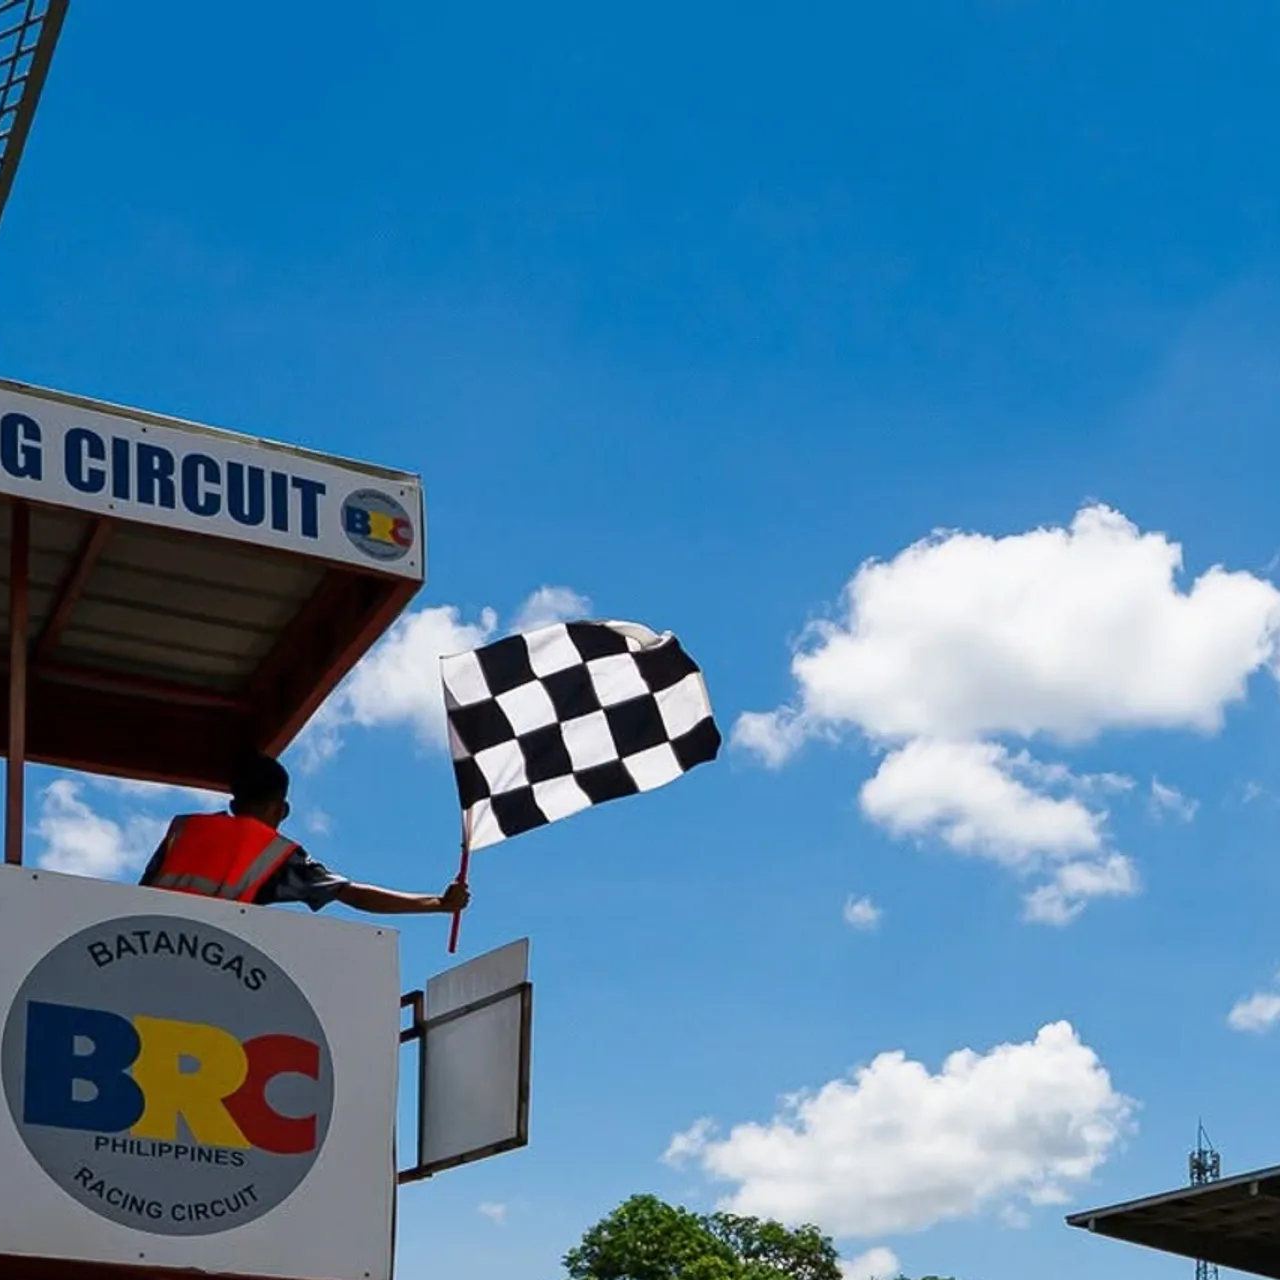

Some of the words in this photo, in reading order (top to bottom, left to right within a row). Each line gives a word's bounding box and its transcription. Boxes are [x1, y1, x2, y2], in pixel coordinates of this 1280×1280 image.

[66, 427, 326, 539] CIRCUIT
[87, 930, 268, 992] BATANGAS
[23, 1000, 319, 1155] BRC
[94, 1135, 245, 1167] PHILIPPINES
[73, 1167, 163, 1221] RACING
[171, 1184, 260, 1222] CIRCUIT
